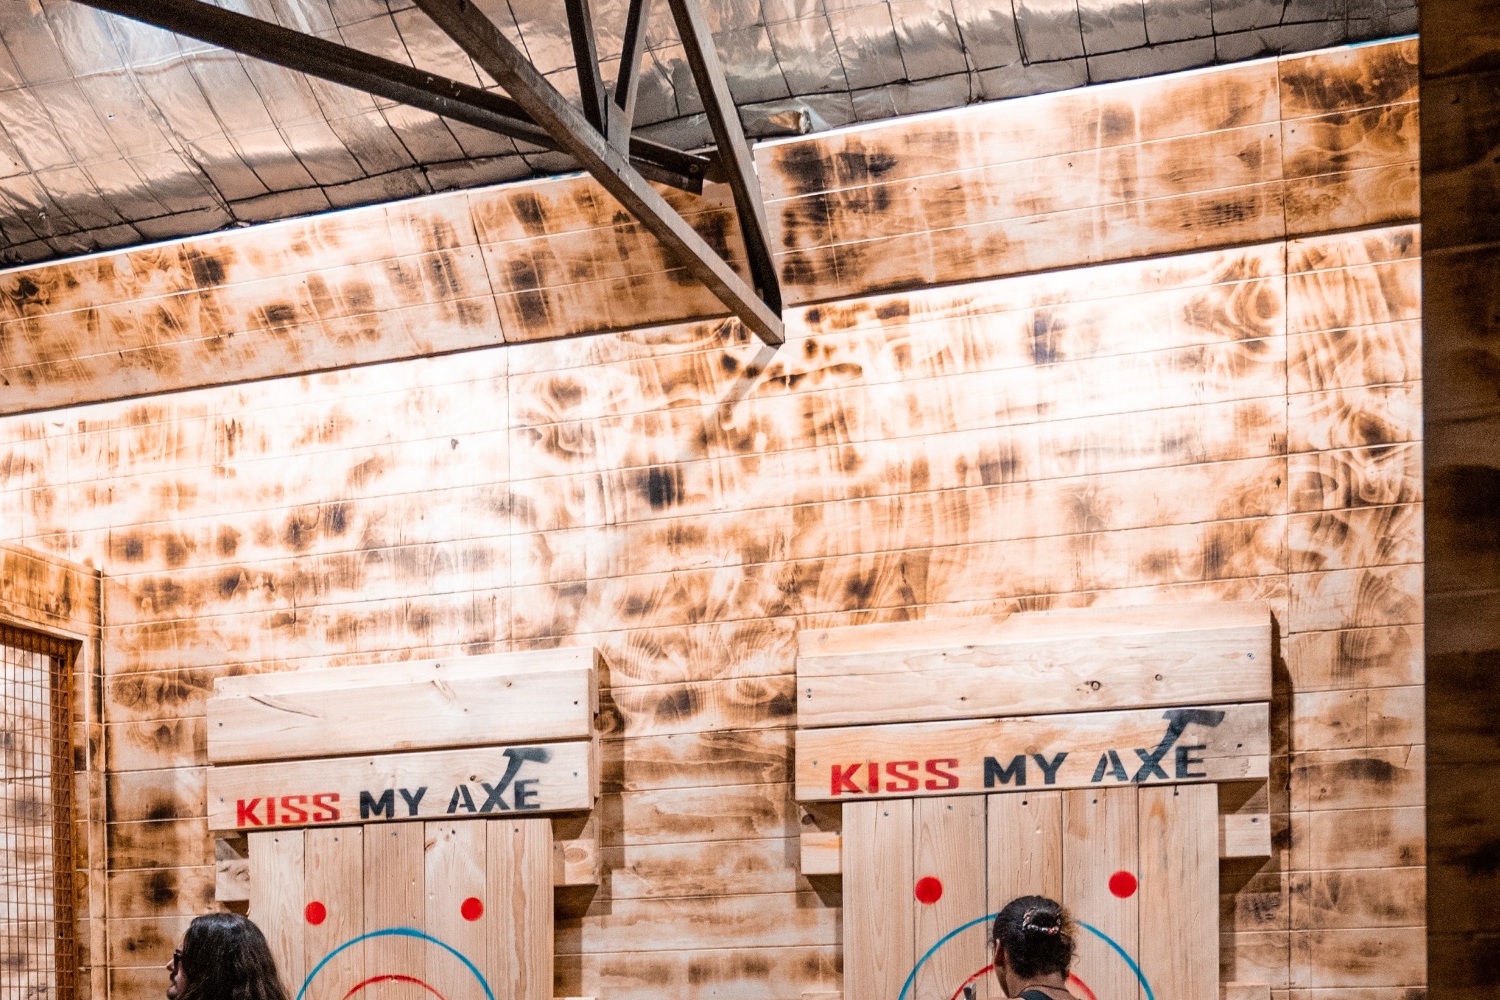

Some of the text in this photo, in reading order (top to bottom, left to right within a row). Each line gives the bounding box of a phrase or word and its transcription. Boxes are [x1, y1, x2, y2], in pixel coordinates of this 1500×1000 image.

[237, 748, 552, 827] KISS MY AXE
[831, 709, 1225, 795] KISS MY AXE
